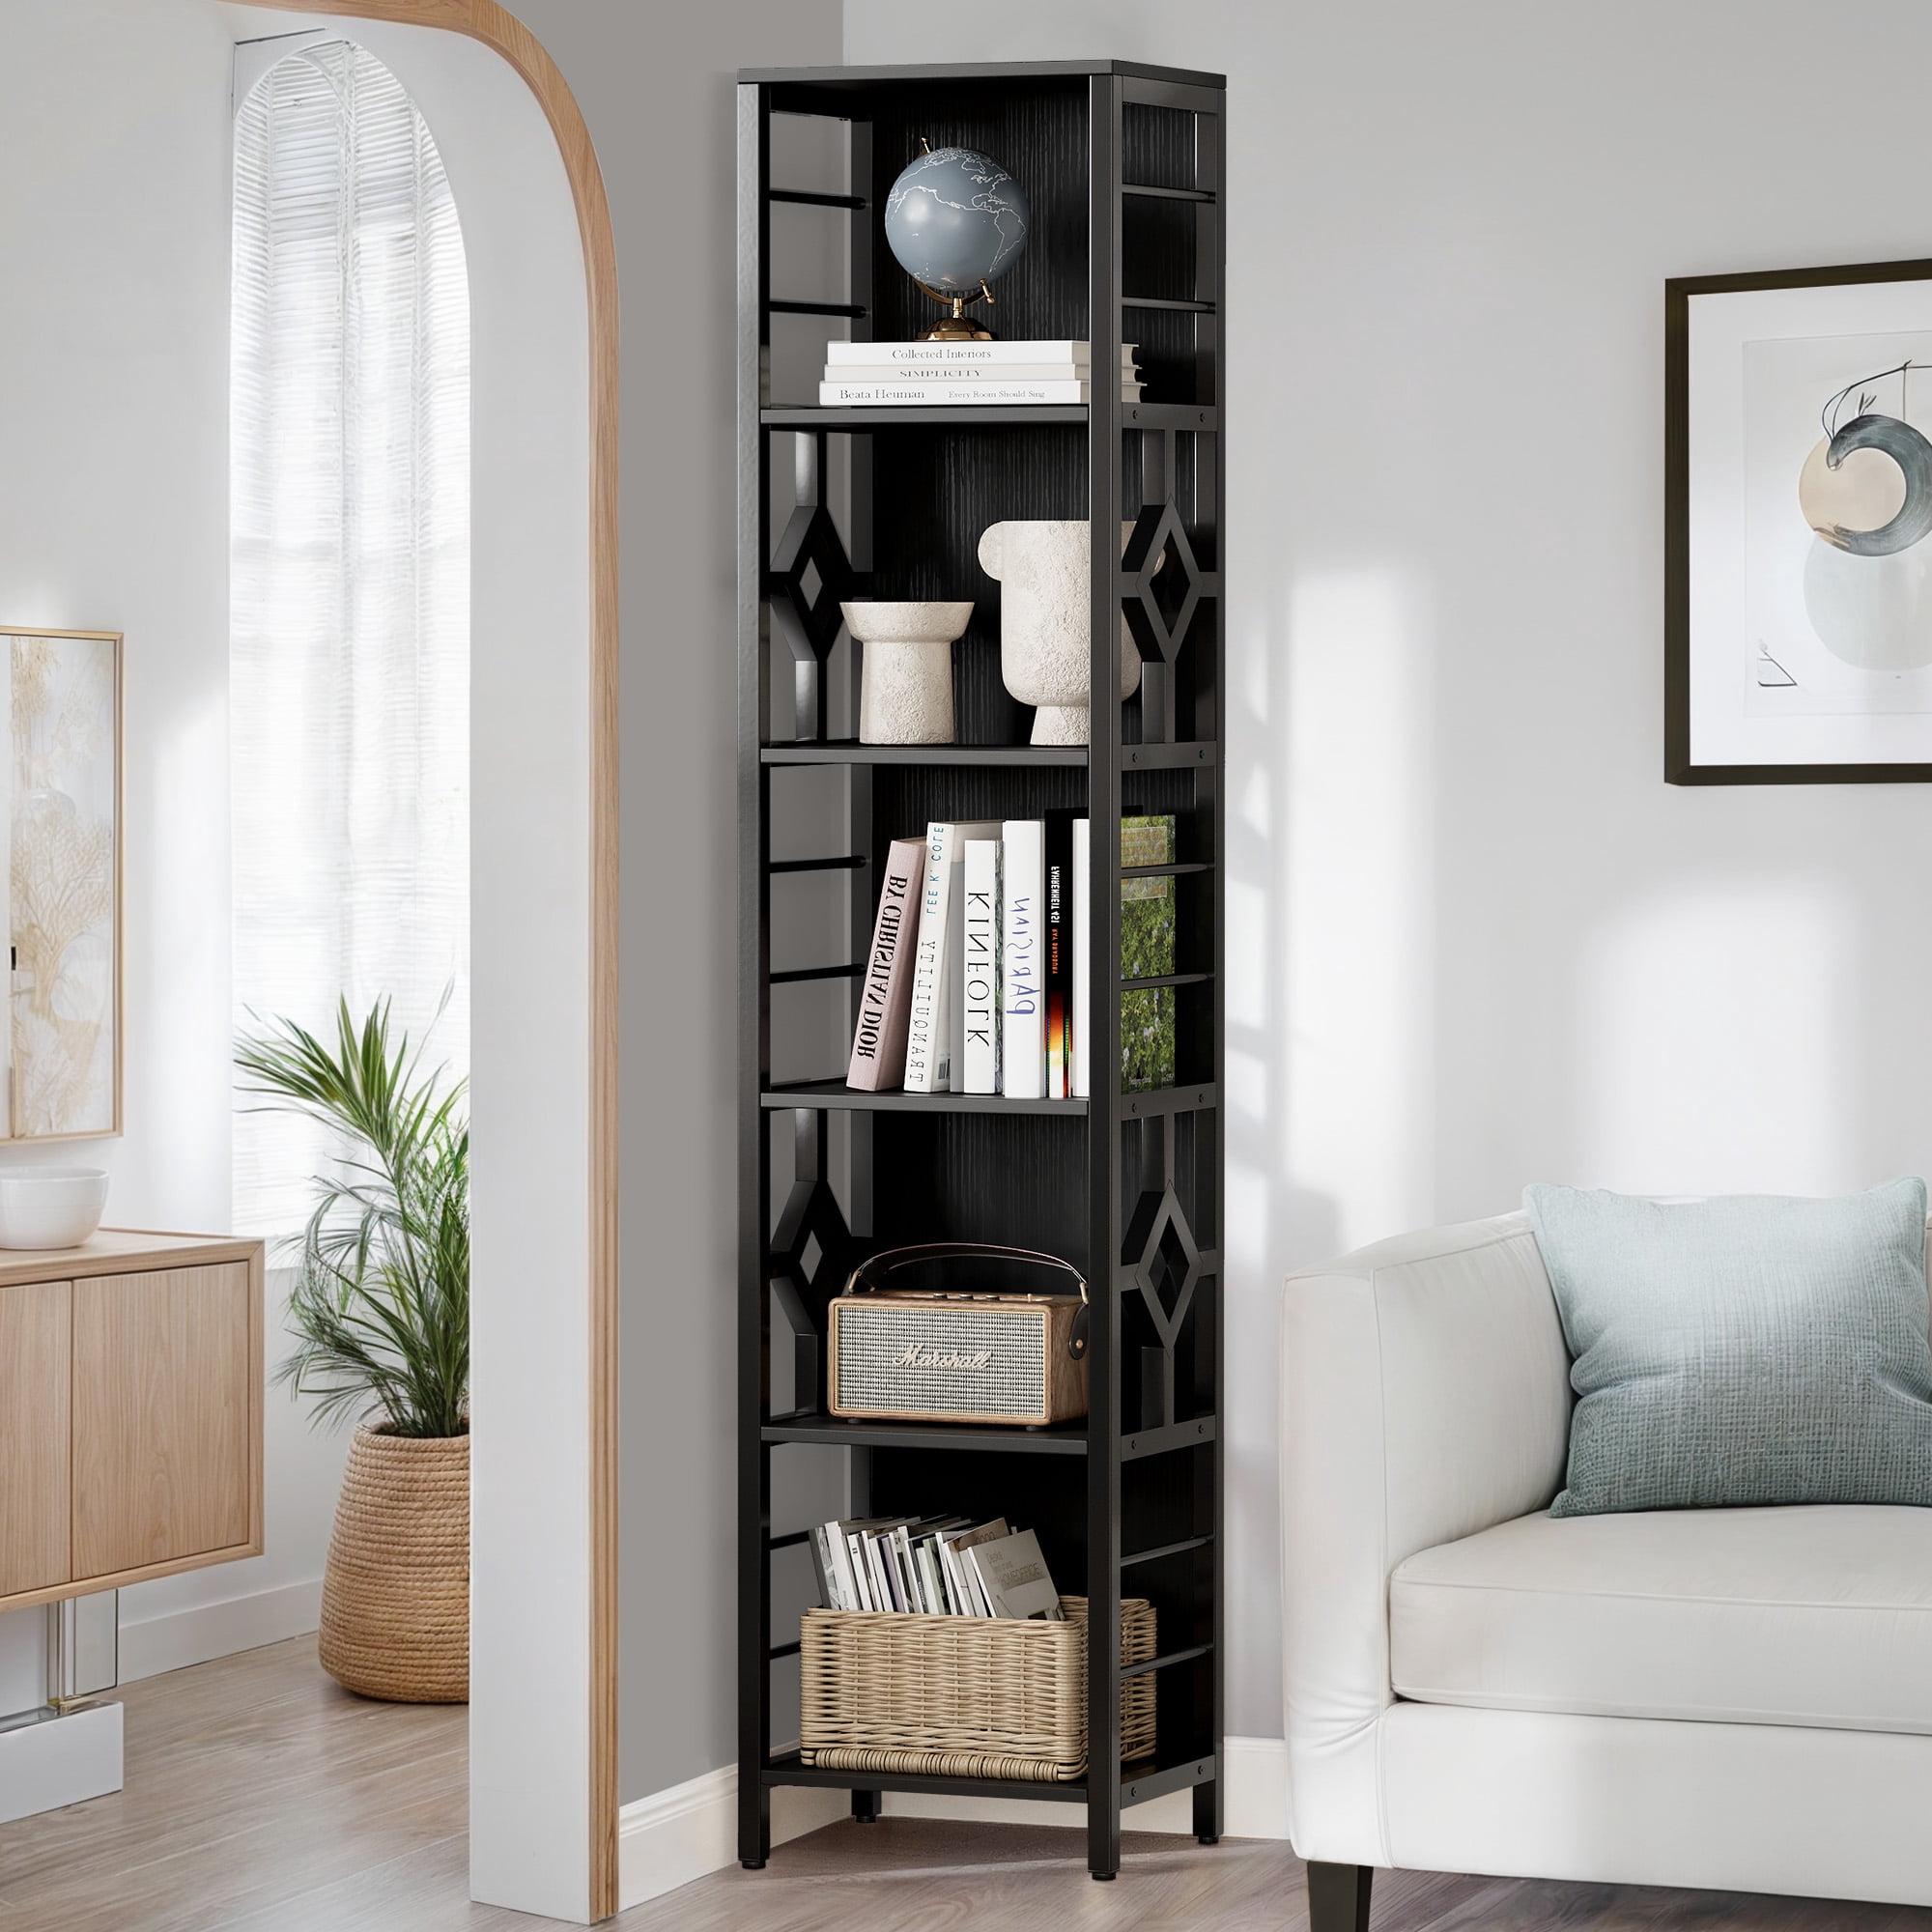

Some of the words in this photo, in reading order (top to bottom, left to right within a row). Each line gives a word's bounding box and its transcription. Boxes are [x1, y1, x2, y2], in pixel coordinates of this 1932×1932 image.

[892, 349, 943, 359] Collected
[946, 349, 992, 359] Interiors
[839, 389, 870, 400] Beata
[874, 388, 924, 399] Heuman
[949, 390, 971, 399] Every
[998, 389, 1026, 398] Should
[1028, 389, 1045, 399] Sing
[892, 1343, 992, 1370] Marshall
